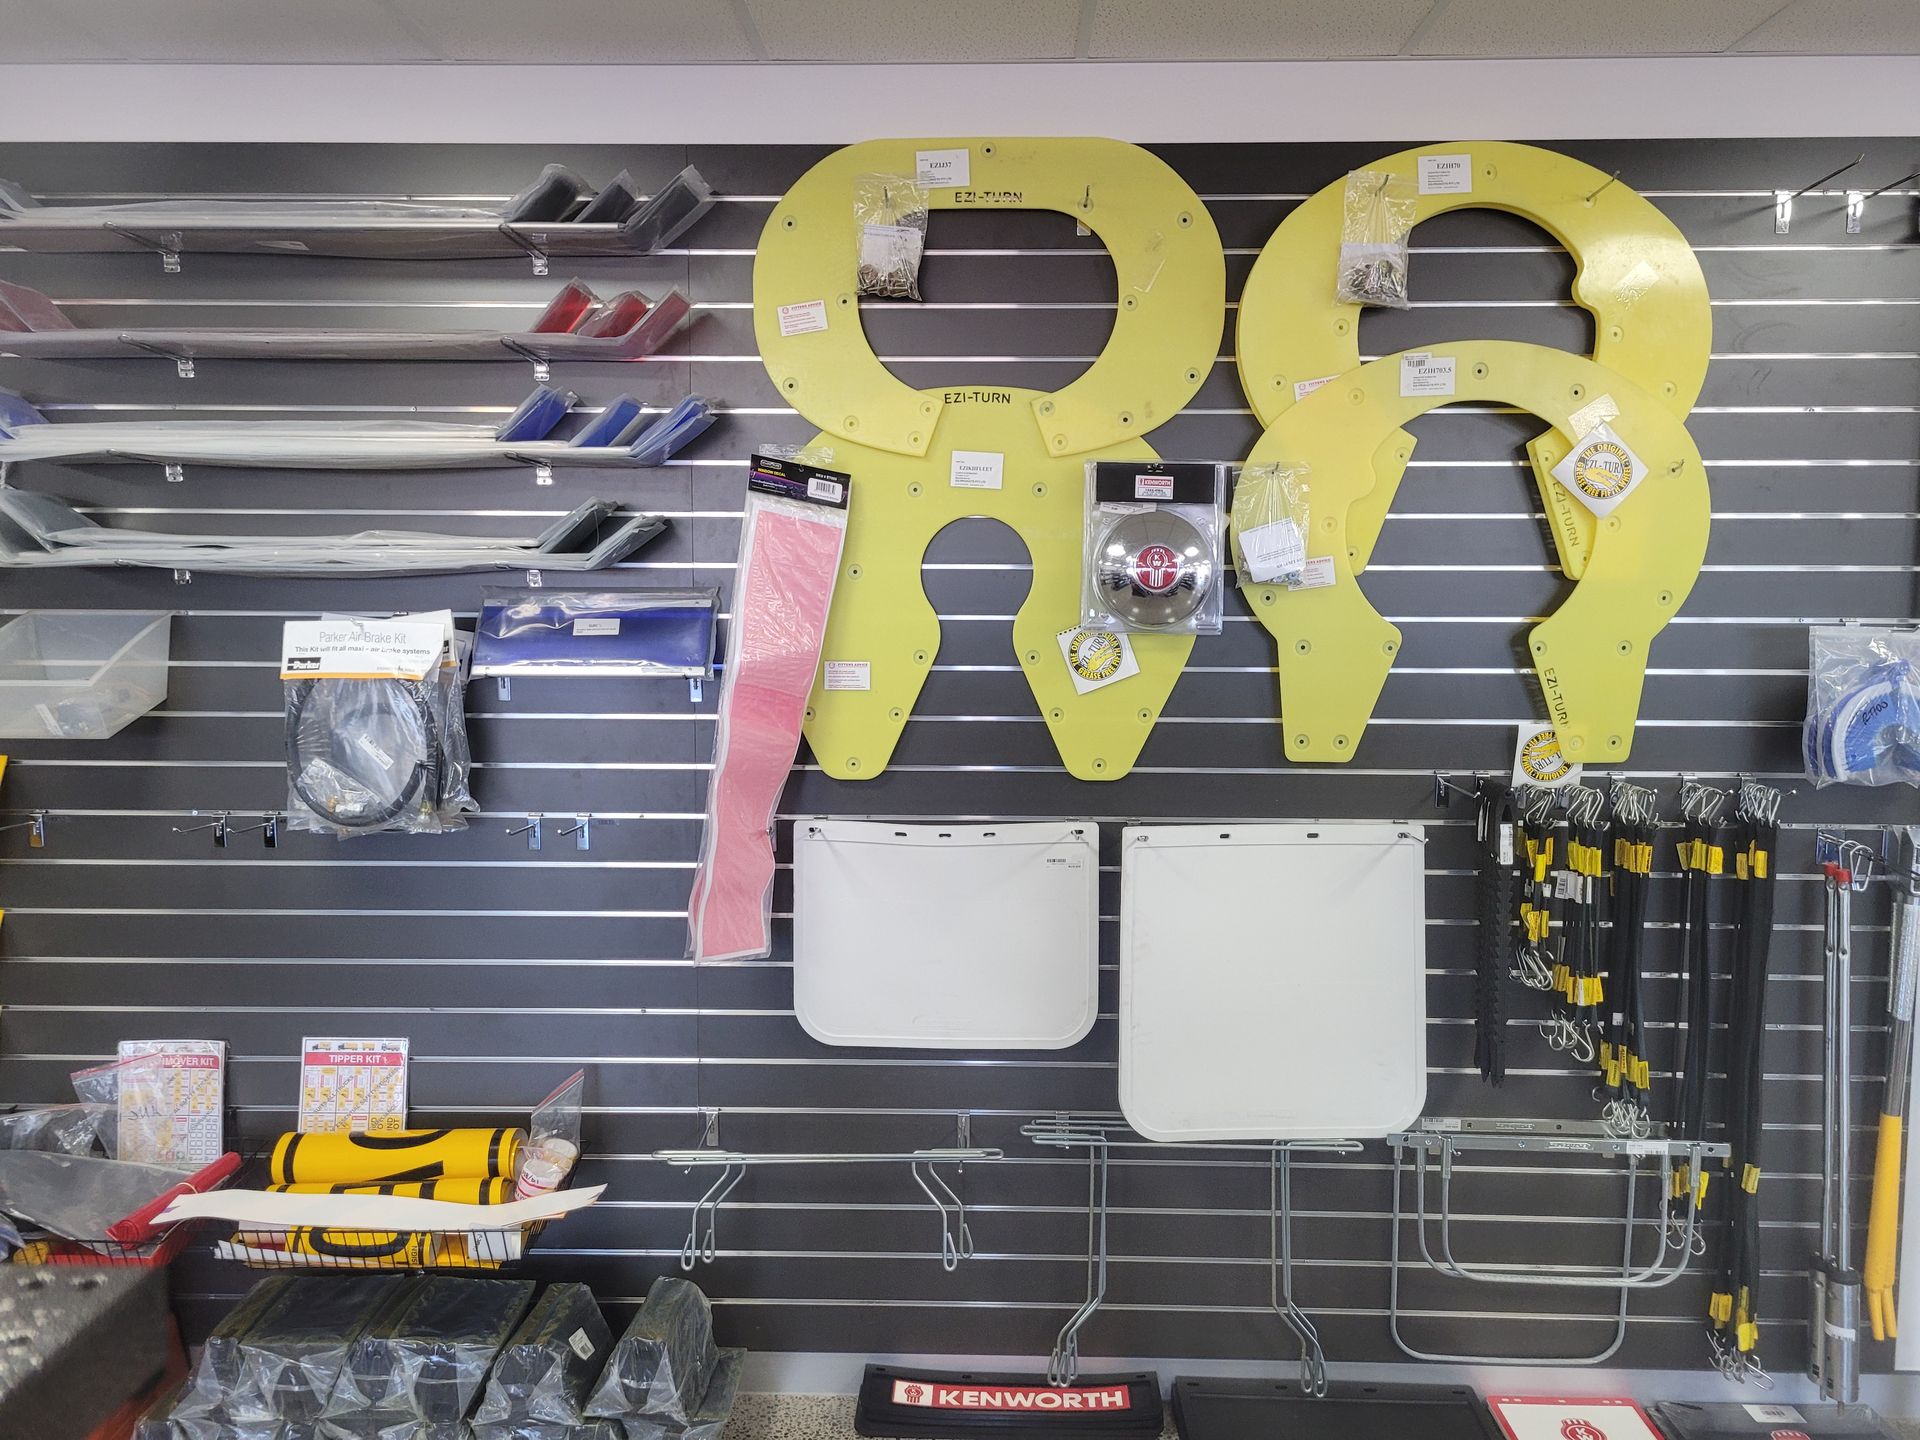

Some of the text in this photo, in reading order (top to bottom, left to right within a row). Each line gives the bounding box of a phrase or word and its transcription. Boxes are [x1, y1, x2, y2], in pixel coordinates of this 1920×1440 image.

[955, 191, 1022, 203] EZI-TURN
[944, 391, 1011, 404] EZI-TURN
[1582, 443, 1629, 466] THE ORIGINAL
[1584, 484, 1599, 497] FREE
[319, 631, 406, 644] Parker Air Brake Kit
[292, 660, 320, 669] Parker
[1070, 652, 1080, 666] THE
[200, 1057, 214, 1066] KIT
[328, 1054, 381, 1063] TIPPER KIT
[939, 1389, 1123, 1409] KENWORTH
